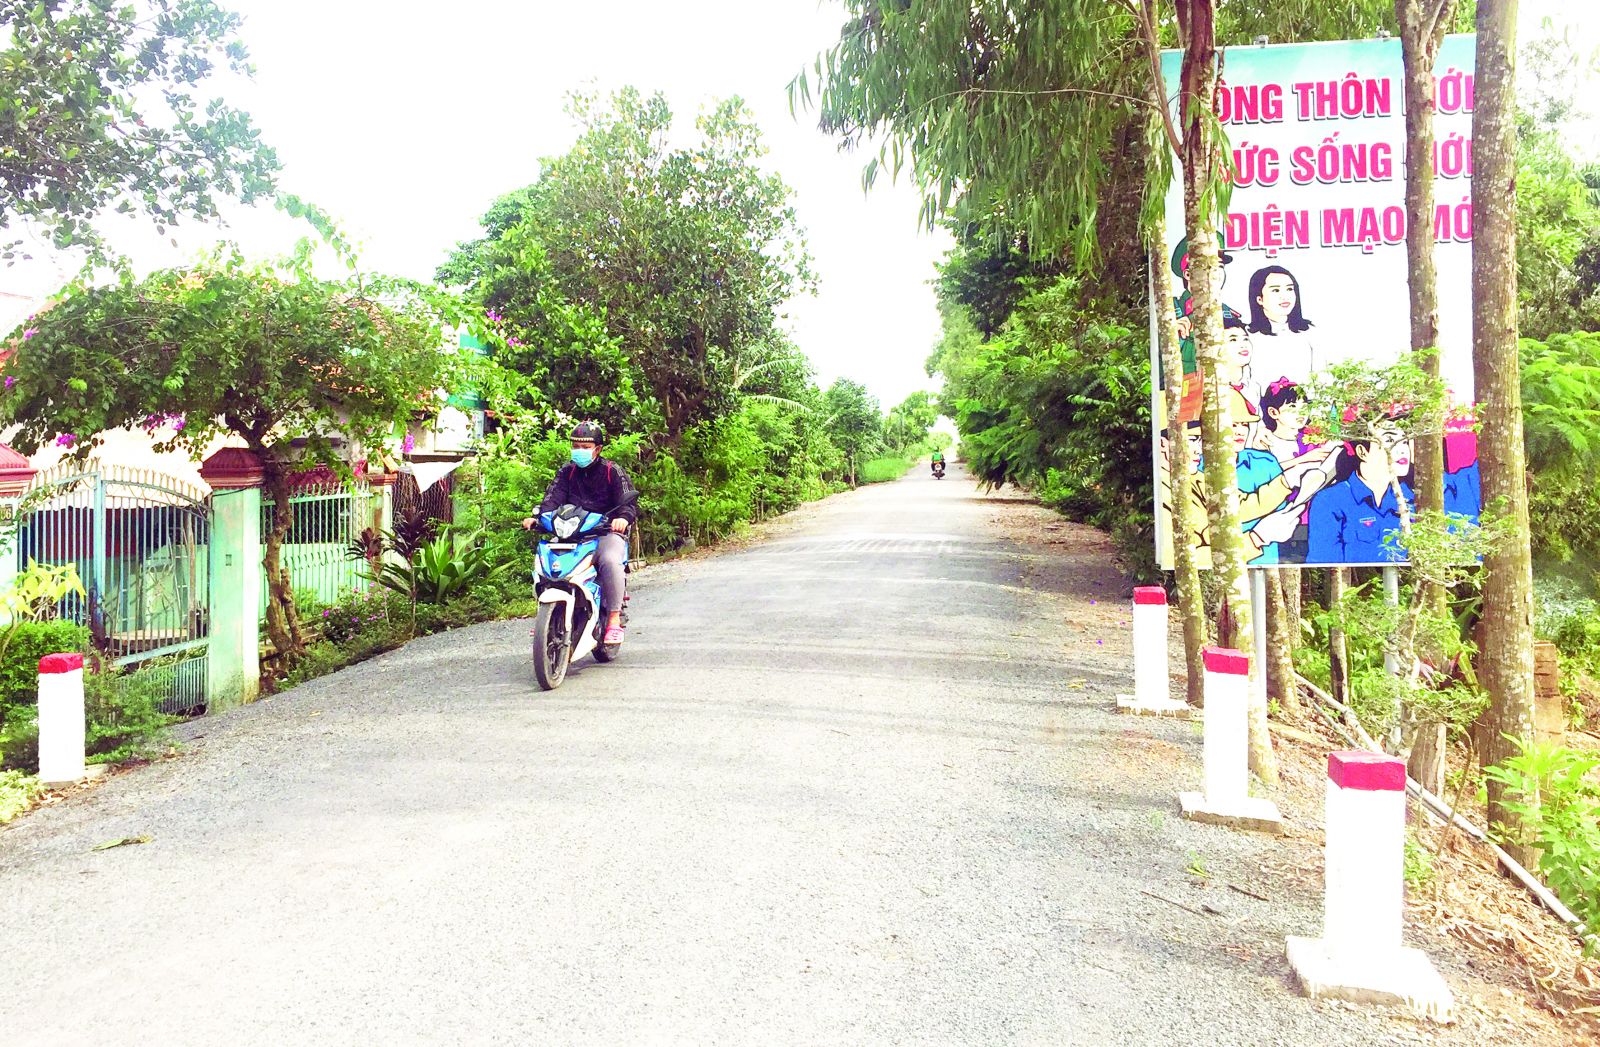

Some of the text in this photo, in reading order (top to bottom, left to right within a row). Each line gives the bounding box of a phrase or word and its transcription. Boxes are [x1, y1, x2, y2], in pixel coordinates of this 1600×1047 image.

[1213, 79, 1283, 123] ÔNG
[1293, 72, 1391, 119] THÔN
[1291, 131, 1392, 184] SỐNG
[1225, 203, 1310, 257] DIỆN
[1322, 205, 1405, 253] MẠO
